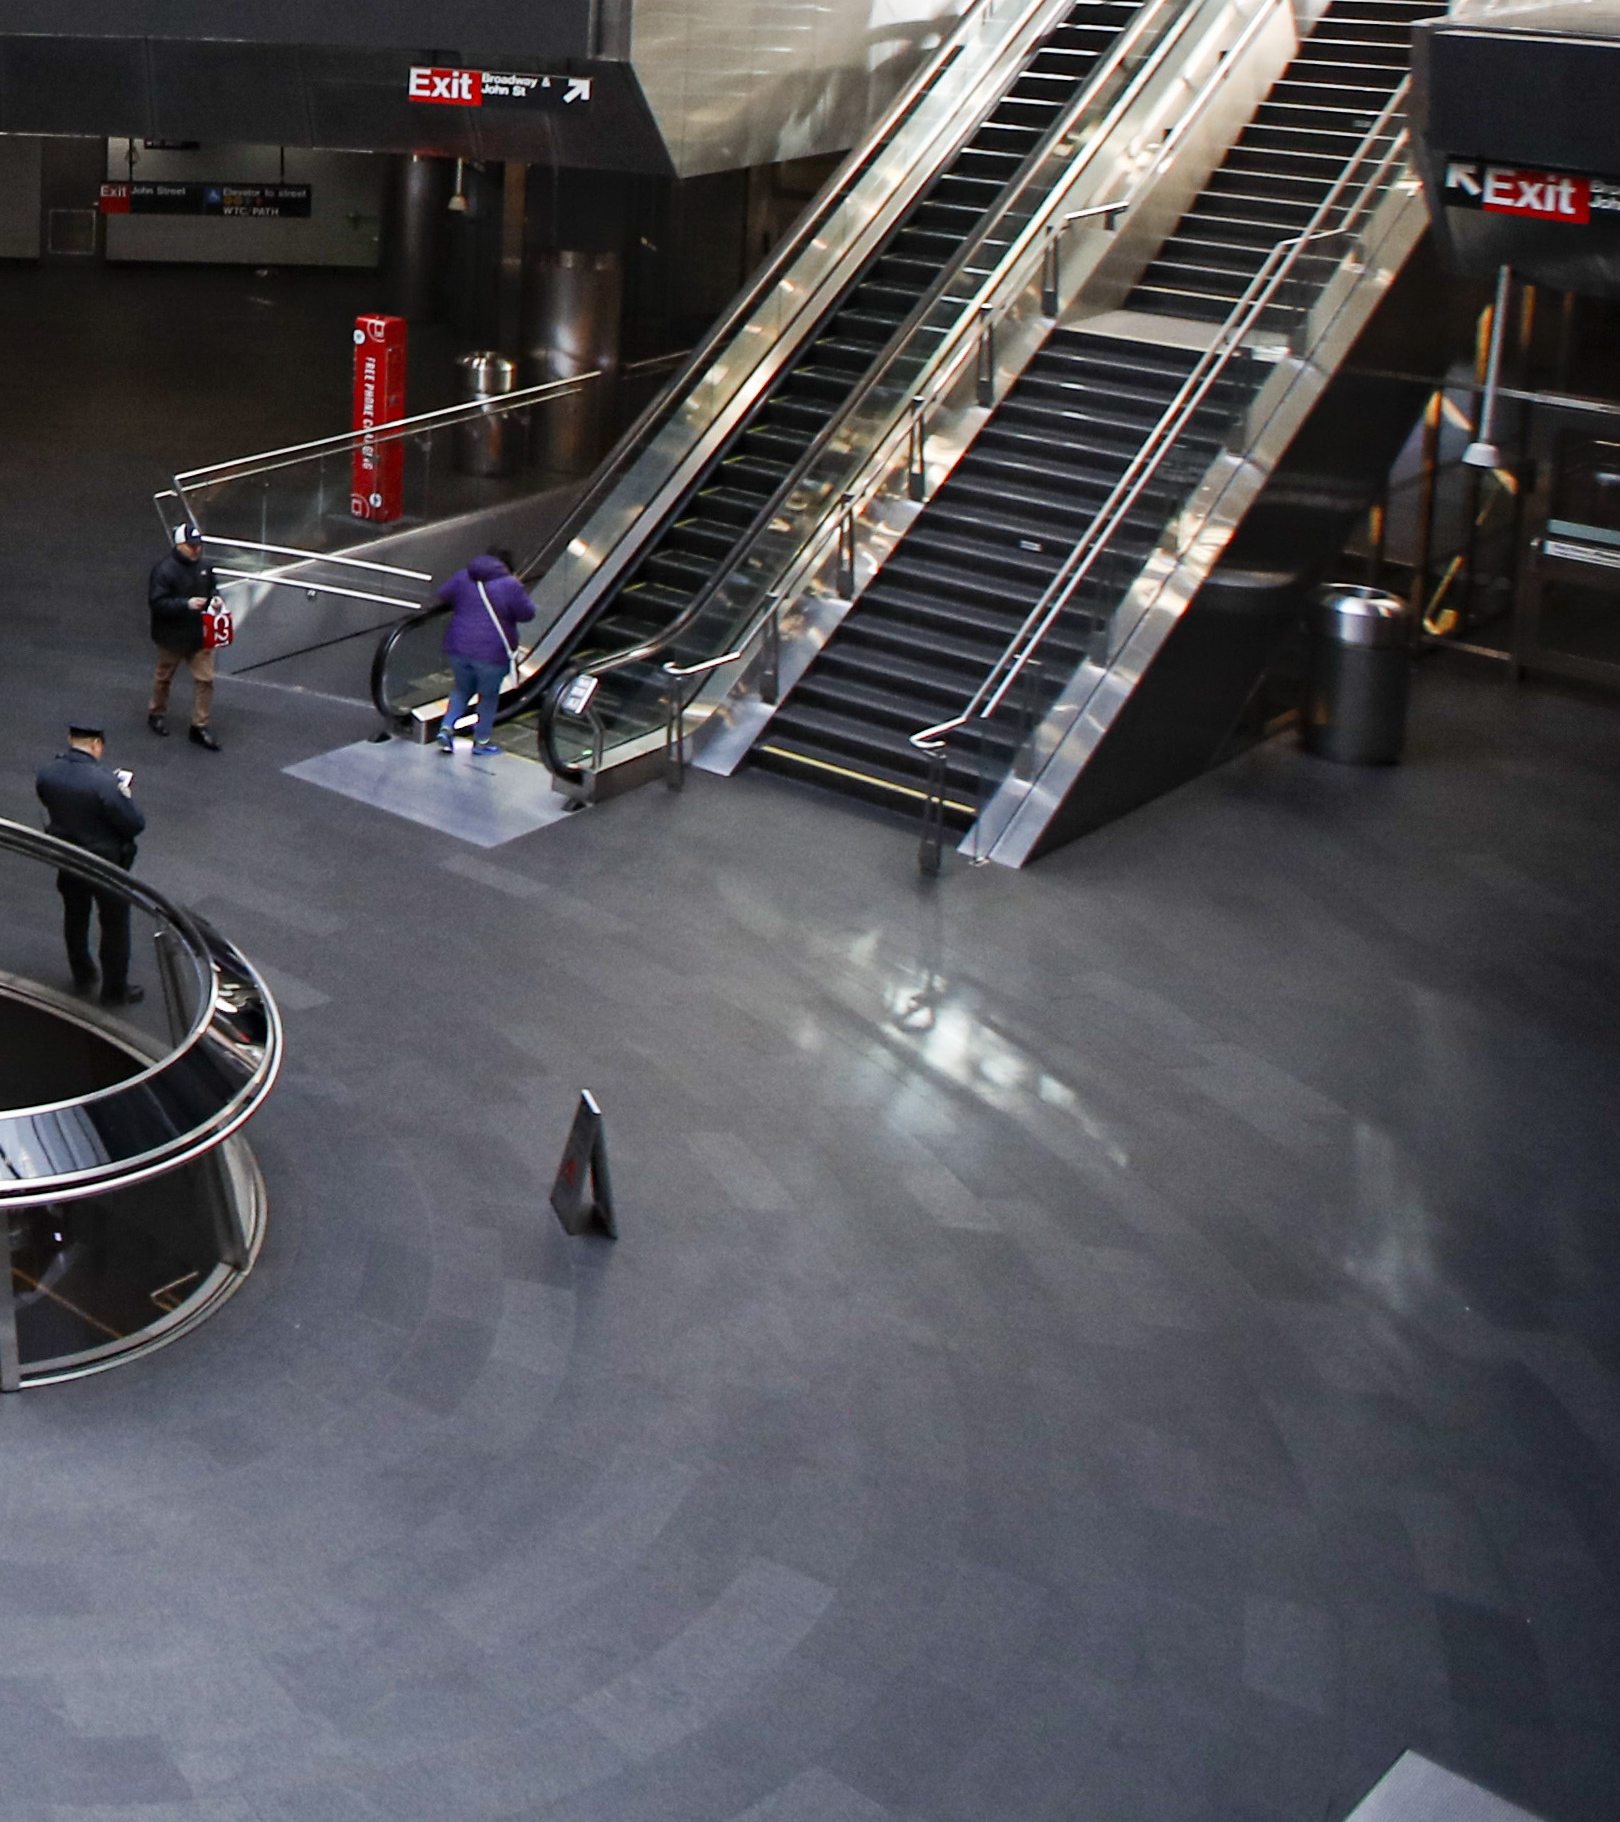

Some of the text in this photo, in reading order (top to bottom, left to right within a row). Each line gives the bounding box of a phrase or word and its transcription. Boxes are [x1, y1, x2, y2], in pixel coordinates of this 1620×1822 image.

[409, 67, 473, 100] Exit
[481, 72, 552, 89] Broadway &
[481, 85, 527, 97] John St
[100, 186, 127, 197] Exit
[131, 186, 154, 196] John
[1482, 167, 1576, 215] Exit
[363, 356, 376, 381] FREE
[363, 382, 375, 418] PHONE
